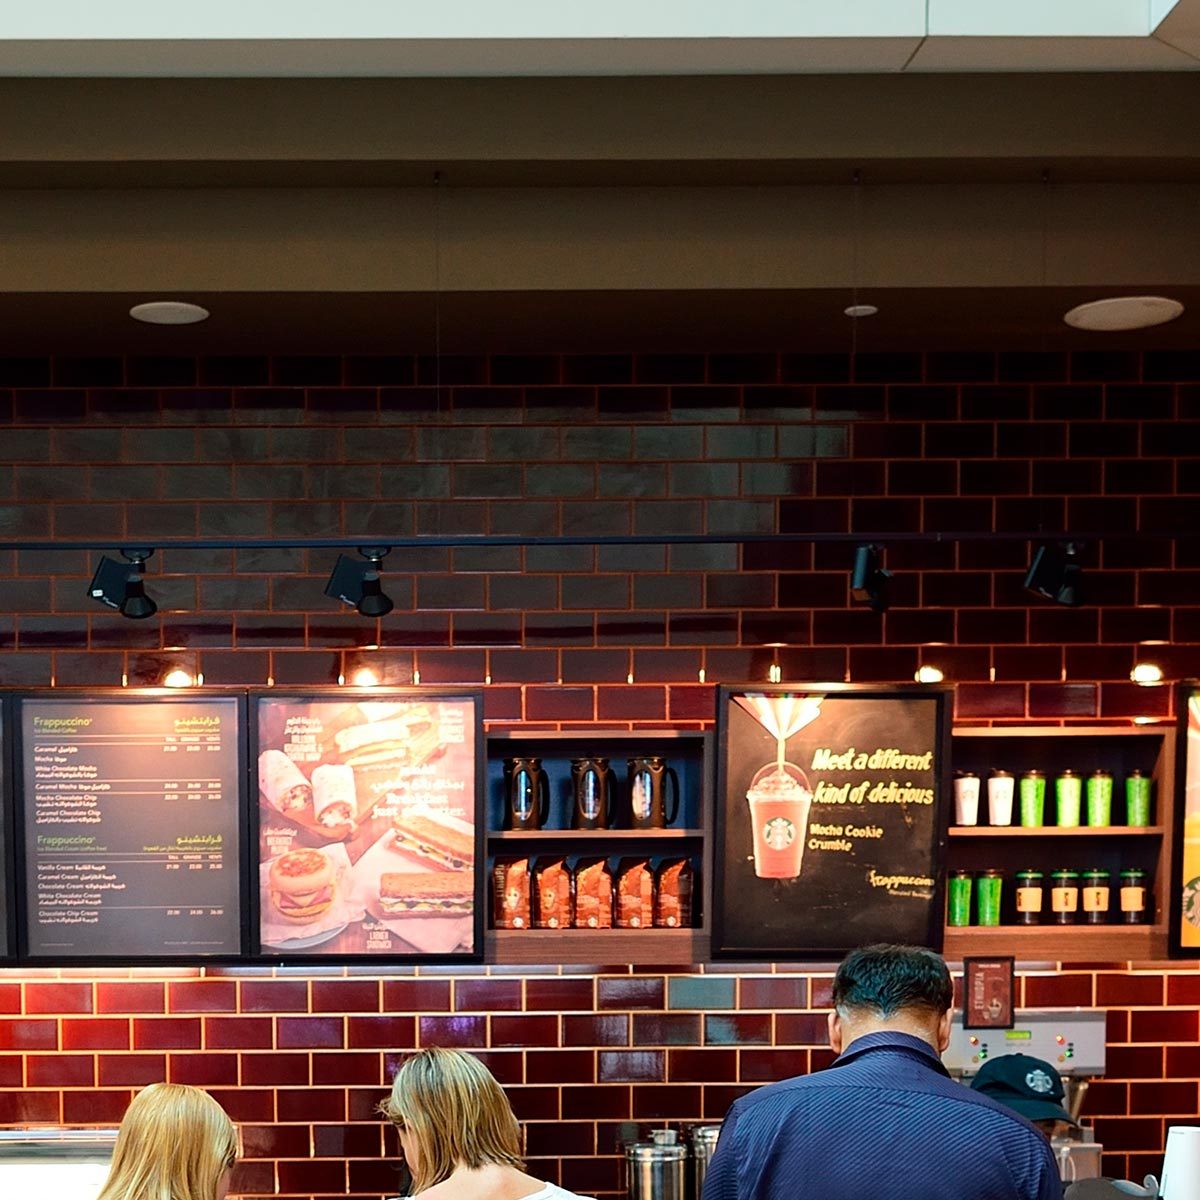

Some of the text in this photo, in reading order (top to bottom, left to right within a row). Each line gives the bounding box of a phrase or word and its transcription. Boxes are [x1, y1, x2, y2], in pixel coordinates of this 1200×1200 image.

[812, 748, 933, 770] Meet a different
[813, 781, 934, 805] kind of delicious
[810, 824, 883, 838] Mocha Cookie
[808, 839, 852, 851] Crumble
[974, 971, 985, 1009] ETHIOPIA
